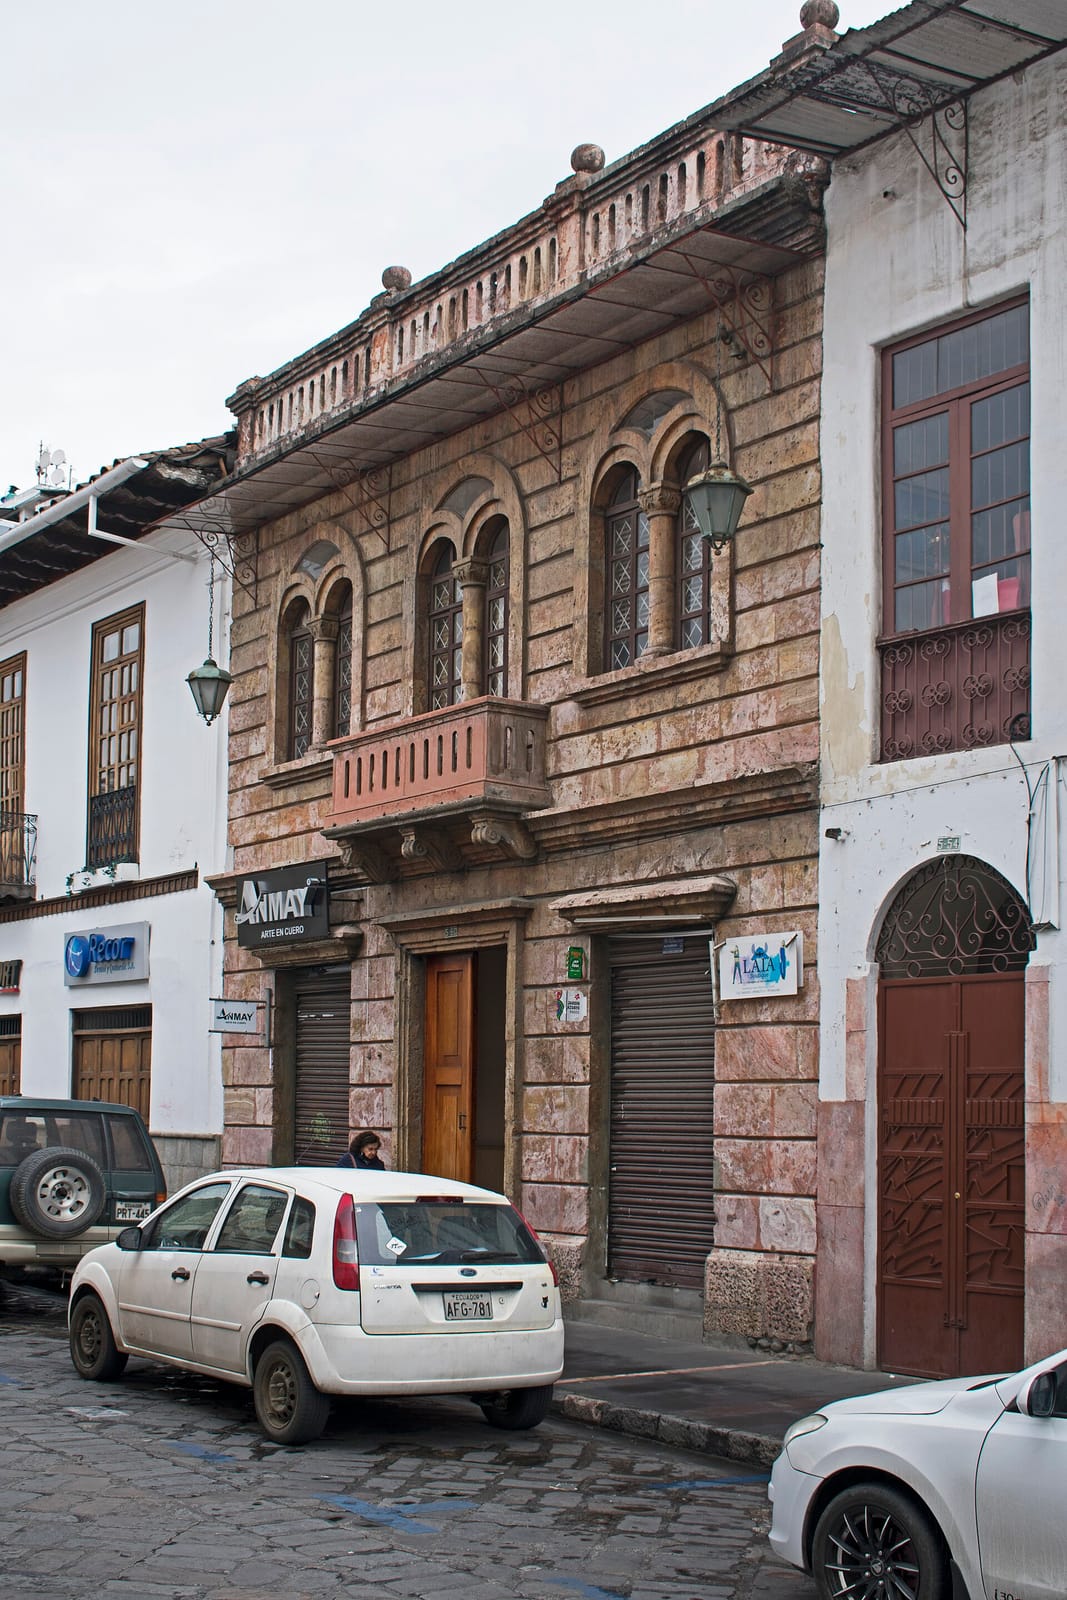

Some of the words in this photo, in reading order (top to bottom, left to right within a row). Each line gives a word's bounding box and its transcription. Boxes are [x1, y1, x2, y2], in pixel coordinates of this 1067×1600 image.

[234, 880, 310, 924] ANMAY
[260, 928, 275, 939] ARTE
[276, 928, 284, 937] EN
[285, 925, 305, 936] CUERO
[88, 933, 135, 963] Recor
[216, 1008, 255, 1021] ANMAY
[455, 1293, 480, 1301] ECUADOR
[447, 1302, 491, 1318] AFG-781
